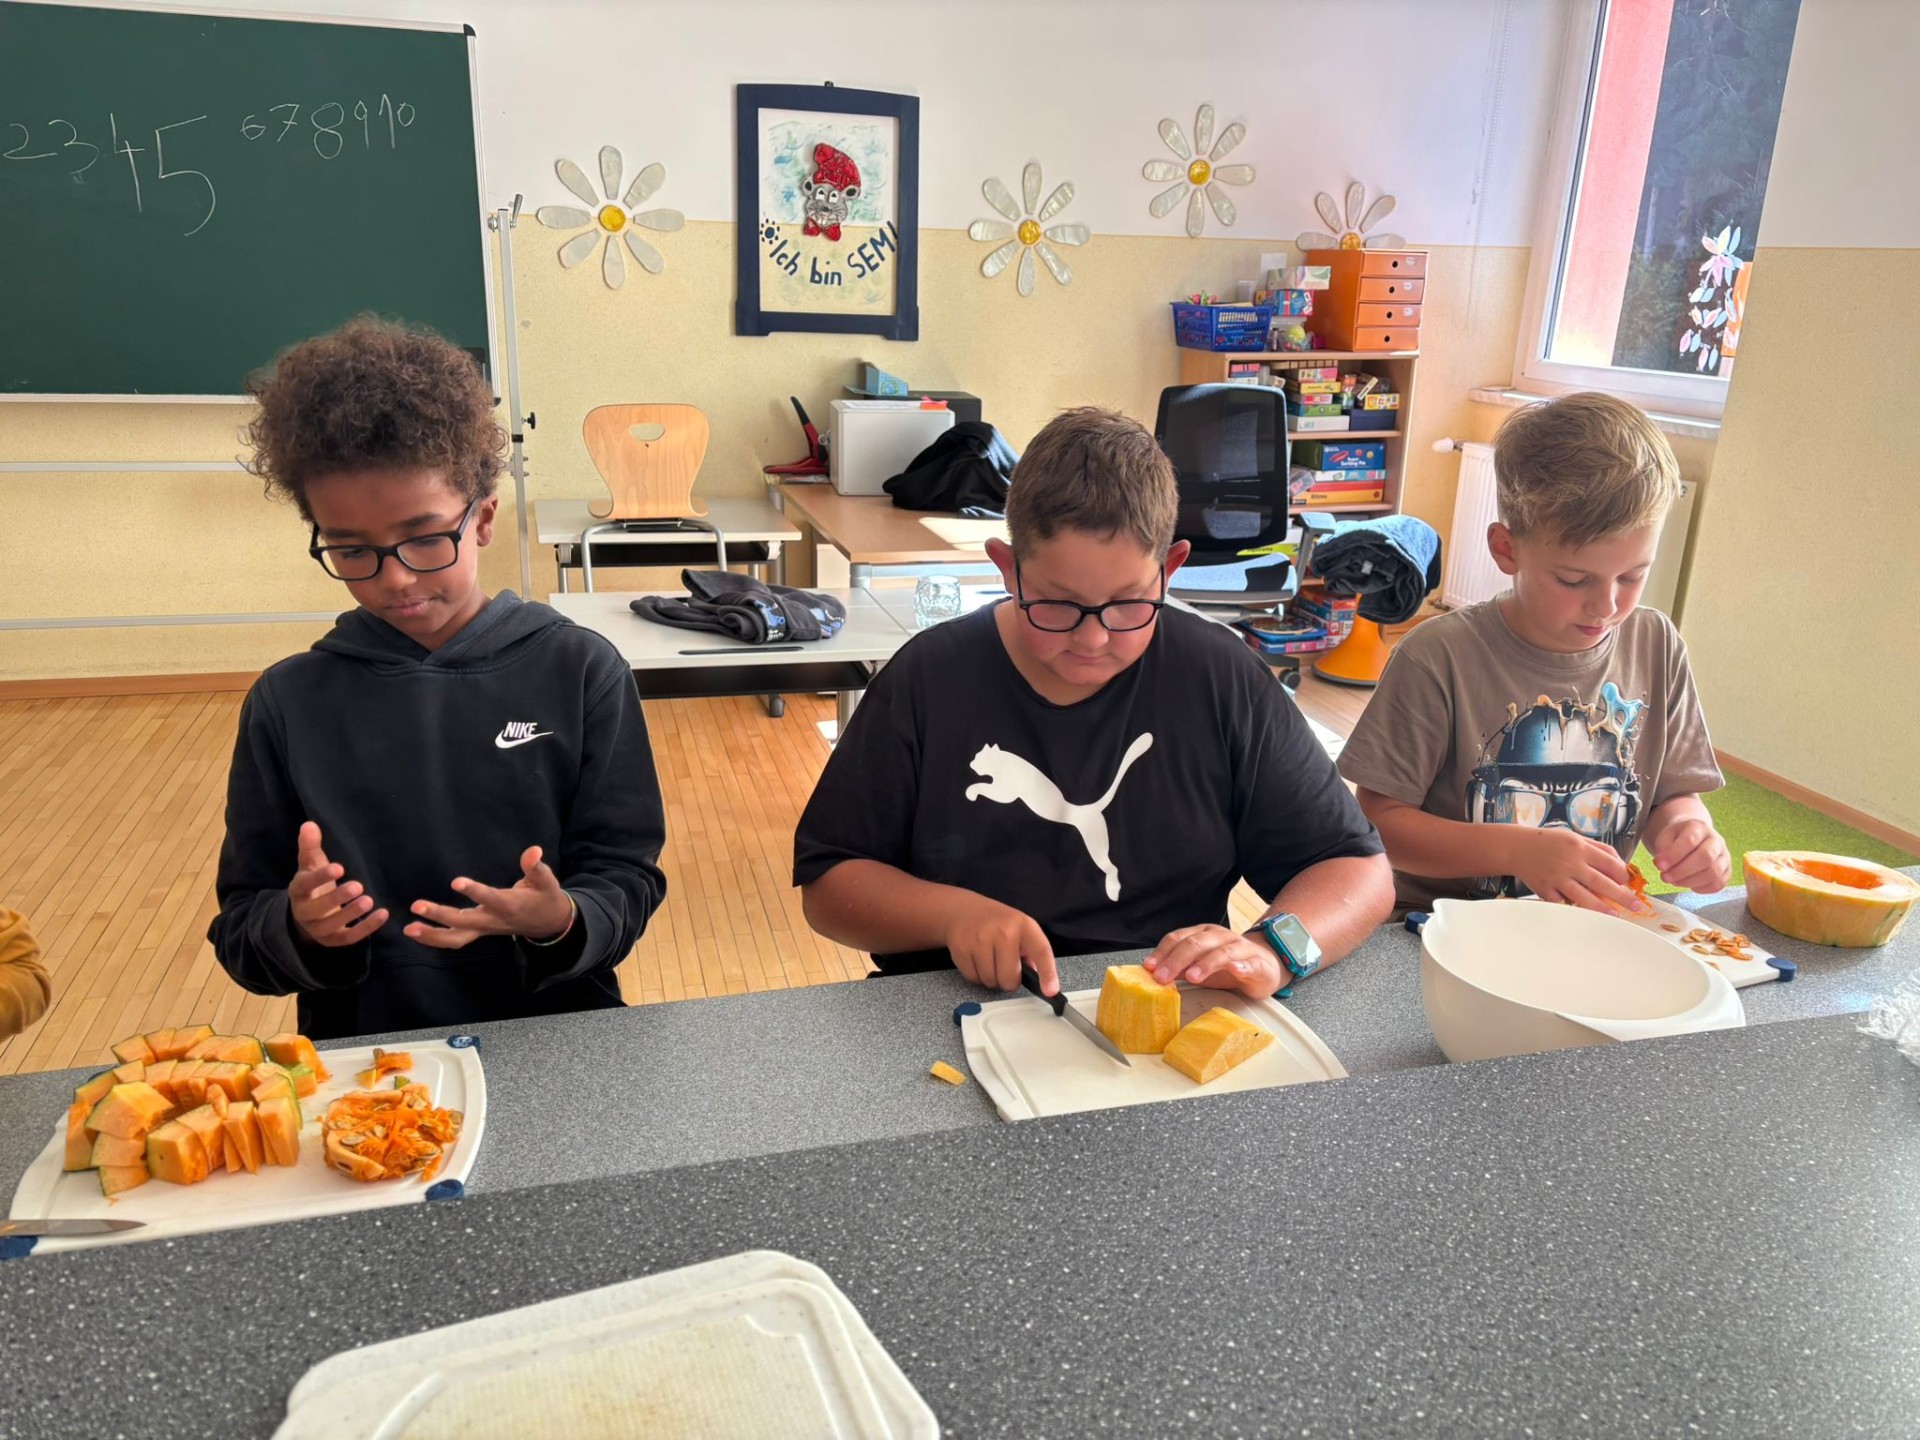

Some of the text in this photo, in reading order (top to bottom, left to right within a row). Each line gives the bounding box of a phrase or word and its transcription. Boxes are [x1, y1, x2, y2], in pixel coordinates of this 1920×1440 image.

[769, 239, 801, 276] Ich
[810, 256, 842, 286] bin
[503, 721, 538, 738] NIKE
